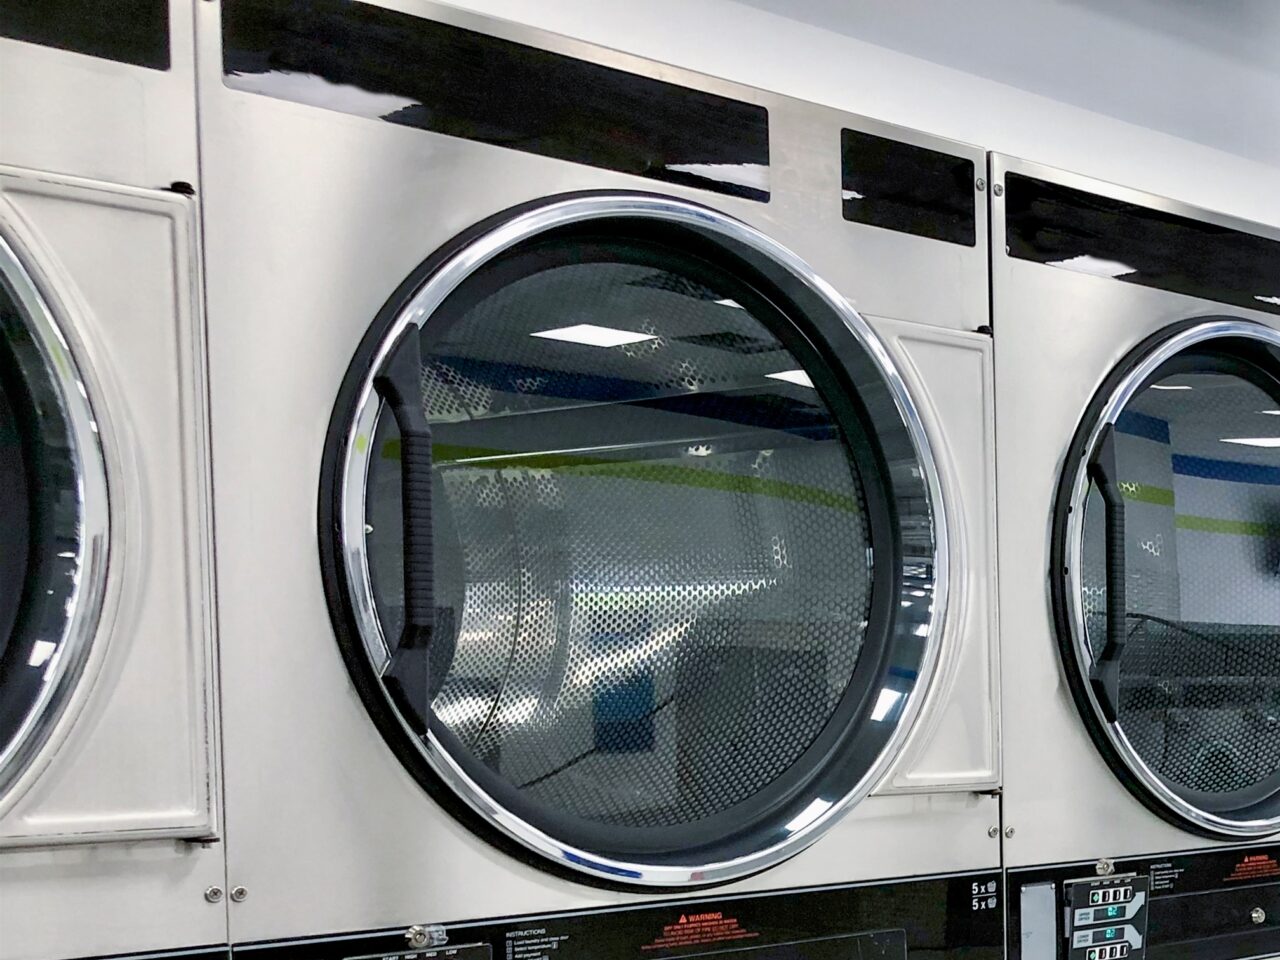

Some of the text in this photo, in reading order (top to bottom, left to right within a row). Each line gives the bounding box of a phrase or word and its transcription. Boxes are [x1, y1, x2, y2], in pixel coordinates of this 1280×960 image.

[972, 882, 979, 894] 5
[972, 898, 979, 911] 5
[688, 912, 723, 923] WARNING
